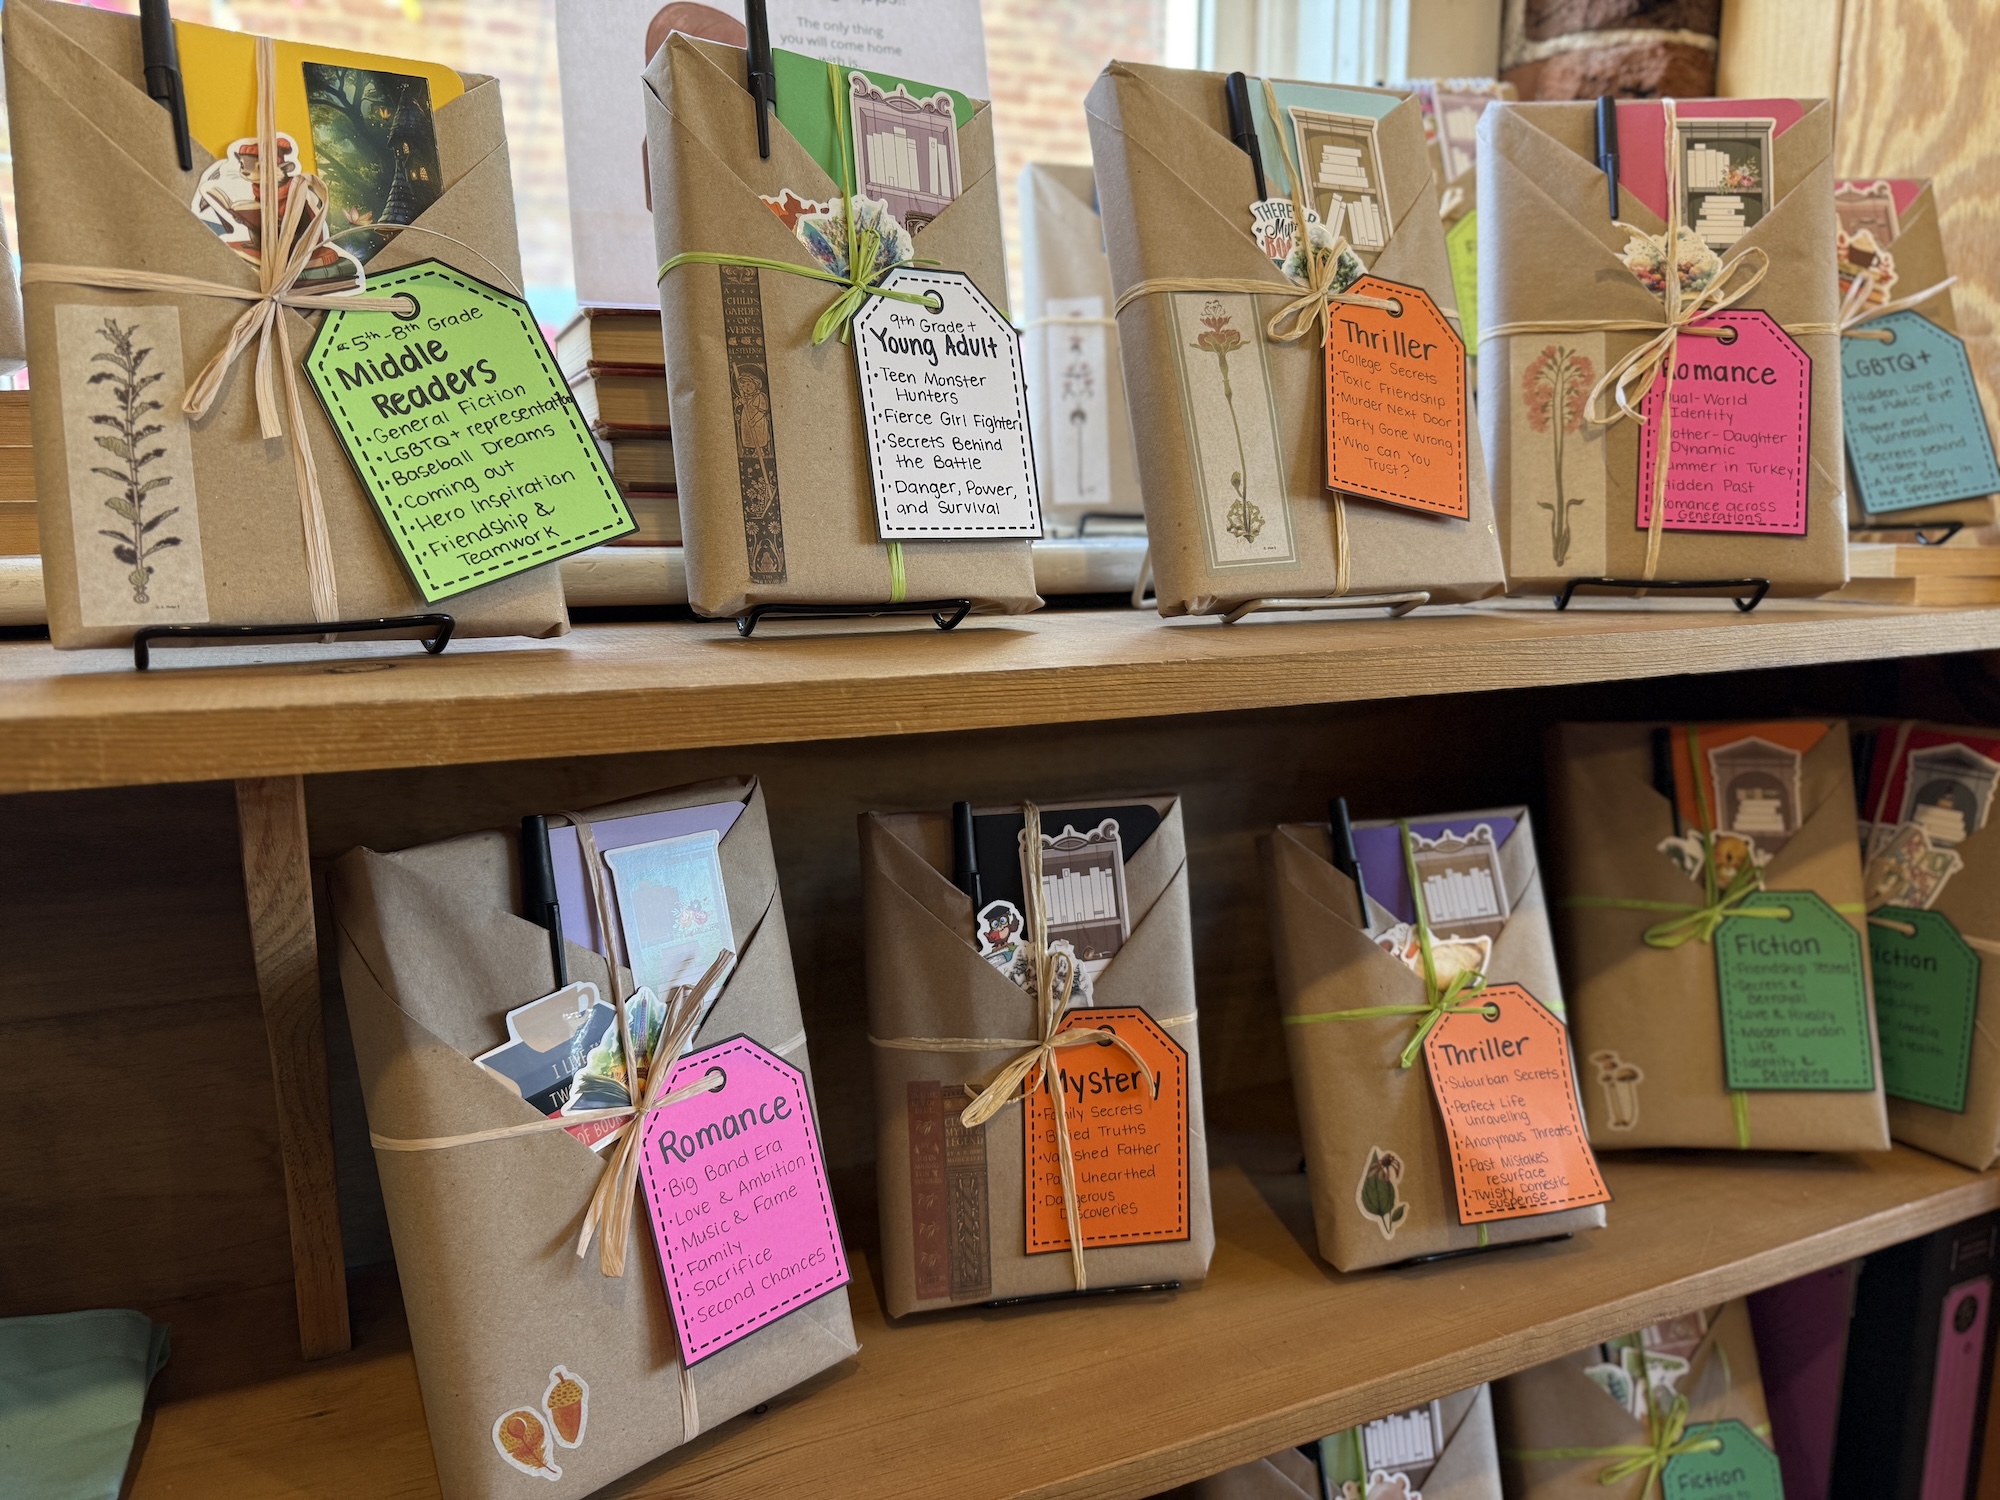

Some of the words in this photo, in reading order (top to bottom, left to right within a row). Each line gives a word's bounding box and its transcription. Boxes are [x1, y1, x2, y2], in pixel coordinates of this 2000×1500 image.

[796, 16, 820, 30] The
[823, 21, 850, 37] only
[852, 24, 885, 40] thing
[779, 34, 804, 47] you
[807, 35, 828, 47] will
[830, 40, 865, 52] come
[867, 42, 902, 56] home
[427, 306, 484, 332] Grade
[729, 326, 762, 334] VERSES
[737, 316, 751, 325] OF
[889, 313, 915, 329] 9th
[869, 326, 939, 367] Young
[945, 334, 998, 359] Adult
[1339, 318, 1438, 361] Thriller
[336, 338, 449, 391] Middle
[1341, 349, 1383, 375] College
[1390, 362, 1438, 385] Secrets
[1842, 350, 1932, 379] LGBTQ+
[370, 358, 497, 420] Readers
[880, 367, 917, 385] Teen
[924, 372, 987, 387] Monster
[1904, 380, 1936, 394] Love
[895, 388, 959, 404] Hunters
[1340, 370, 1372, 391] Toxic
[1379, 383, 1446, 410] Friendship
[1882, 396, 1921, 411] Public
[1926, 388, 1953, 403] Eye
[373, 411, 450, 444] General
[457, 383, 527, 416] Fiction
[884, 409, 933, 425] Fierce
[940, 412, 967, 427] Girl
[973, 414, 1020, 433] Fighter
[1341, 392, 1383, 412] Murder
[1387, 404, 1417, 420] Next
[1423, 412, 1453, 428] Door
[1670, 406, 1734, 426] Identity
[1901, 412, 1930, 427] and
[1341, 411, 1374, 435] Party
[1379, 423, 1409, 441] Gone
[384, 429, 460, 464] LGBTQ+
[887, 433, 945, 448] Secrets
[952, 437, 1003, 451] Behind
[1342, 436, 1370, 452] Who
[1407, 451, 1431, 467] You
[1670, 441, 1736, 456] Dynamic
[392, 449, 474, 487] Baseball
[481, 423, 556, 456] Dreams
[895, 454, 925, 469] the
[933, 455, 983, 470] Battle
[1364, 457, 1411, 479] Trust?
[1667, 461, 1717, 473] ummer
[1724, 462, 1738, 473] in
[1746, 462, 1794, 481] Turkey
[404, 477, 480, 510] Coming
[484, 460, 515, 480] out
[895, 479, 962, 499] Danger,
[966, 481, 1018, 500] Power,
[1723, 479, 1755, 493] Past
[415, 506, 466, 532] Hero
[472, 468, 576, 514] Inspiration
[896, 500, 928, 515] and
[938, 501, 1000, 515] Survival
[1725, 501, 1777, 513] across
[1677, 509, 1763, 523] Generations
[428, 512, 529, 558] Friendship
[534, 501, 556, 518] &
[456, 525, 560, 567] Teamwork
[1735, 932, 1822, 957] Fiction
[1873, 947, 1938, 973] iction
[1438, 1035, 1530, 1067] Thriller
[551, 1063, 562, 1080] I
[1448, 1072, 1510, 1090] Suburban
[1514, 1067, 1560, 1082] Secrets
[1043, 1067, 1161, 1104] Mystery
[1090, 1103, 1143, 1119] Secrets
[1454, 1098, 1496, 1114] Perfect
[1500, 1094, 1526, 1109] Life
[657, 1095, 793, 1165] Romance
[1045, 1127, 1091, 1143] Bied
[1097, 1123, 1147, 1137] Truths
[1464, 1131, 1527, 1150] Anonymous
[1530, 1123, 1573, 1140] Threats
[1043, 1145, 1110, 1163] Vashed
[1117, 1142, 1161, 1156] Father
[1469, 1157, 1495, 1172] Past
[1500, 1151, 1549, 1168] Mistakes
[668, 1175, 700, 1199] Big
[703, 1151, 750, 1182] Band
[754, 1138, 784, 1162] Era
[1081, 1163, 1157, 1183] Unearthed
[1486, 1167, 1547, 1186] resurface
[674, 1200, 712, 1227] Love
[719, 1189, 734, 1205] &
[738, 1154, 807, 1197] Ambition
[1472, 1186, 1515, 1202] Twisty
[1519, 1175, 1570, 1194] Domestic
[1488, 1191, 1549, 1210] suspense
[681, 1219, 732, 1252] Music
[733, 1209, 749, 1225] &
[753, 1182, 799, 1214] Fame
[686, 1239, 744, 1277] Family
[692, 1246, 774, 1298] Sacrifice
[696, 1284, 756, 1324] Second
[761, 1246, 827, 1291] Chances
[1677, 1467, 1746, 1491] Fiction
